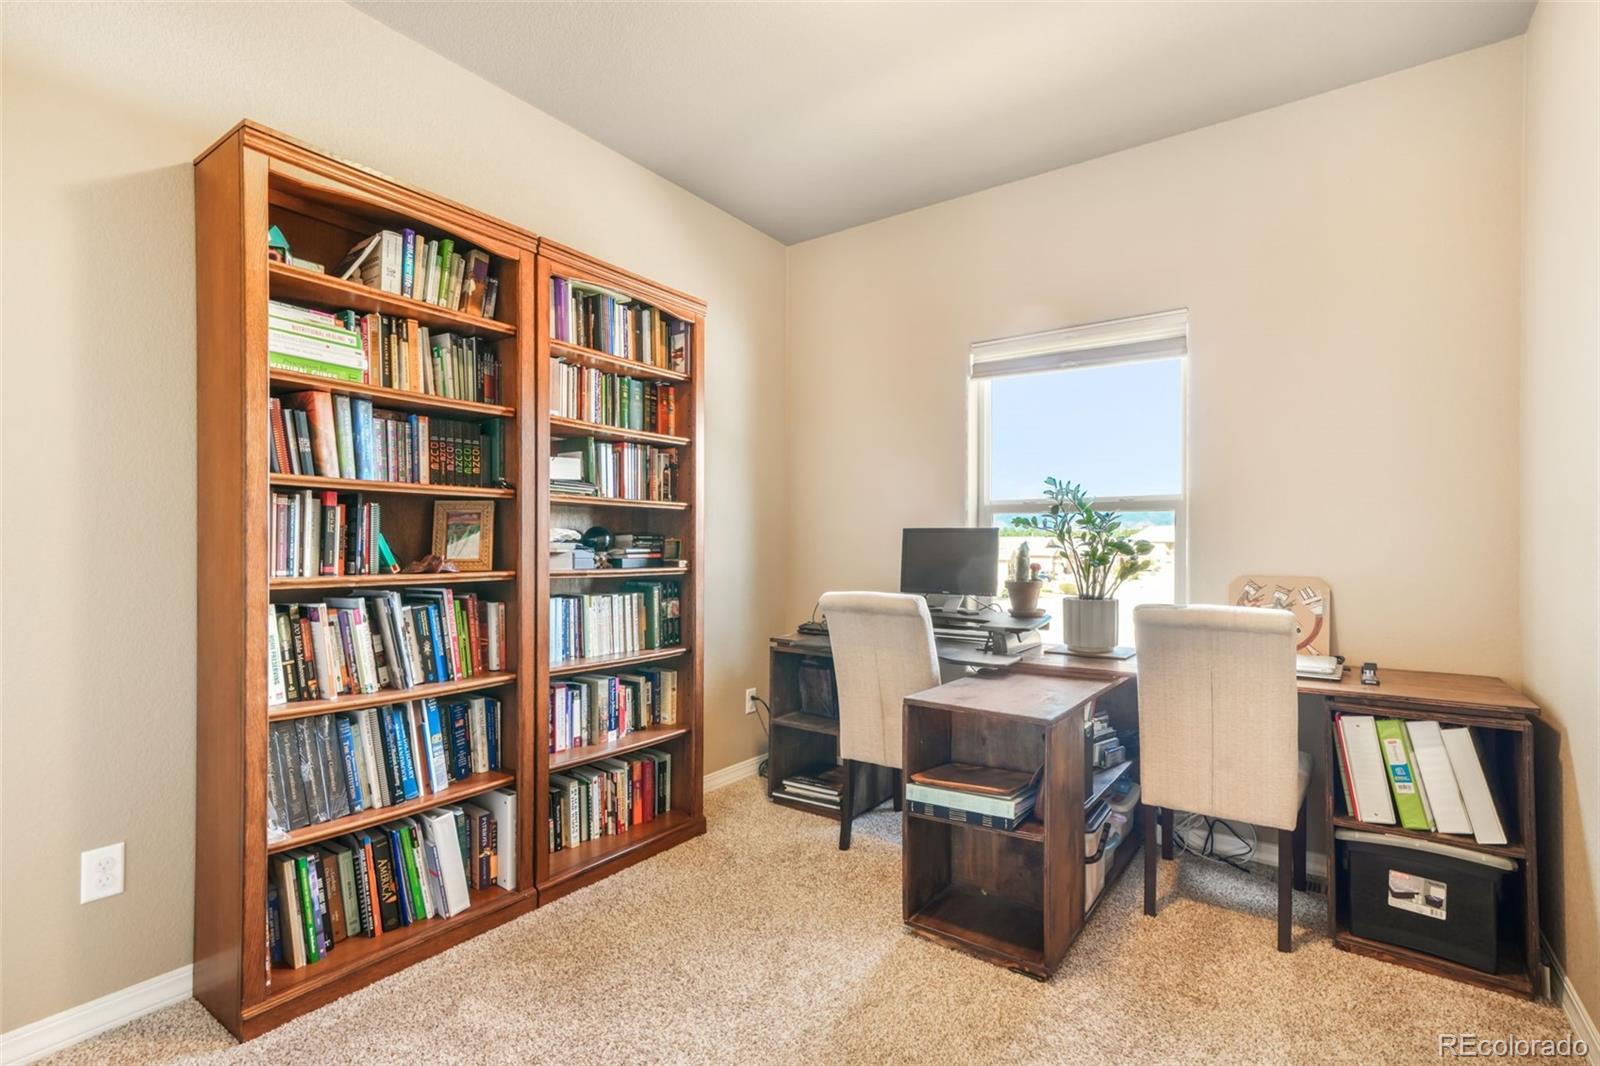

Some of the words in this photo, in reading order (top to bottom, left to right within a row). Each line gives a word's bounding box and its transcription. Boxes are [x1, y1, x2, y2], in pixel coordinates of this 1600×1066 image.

[295, 635, 303, 653] Edible
[297, 653, 306, 687] Mushrooms
[377, 859, 391, 902] AMERICA
